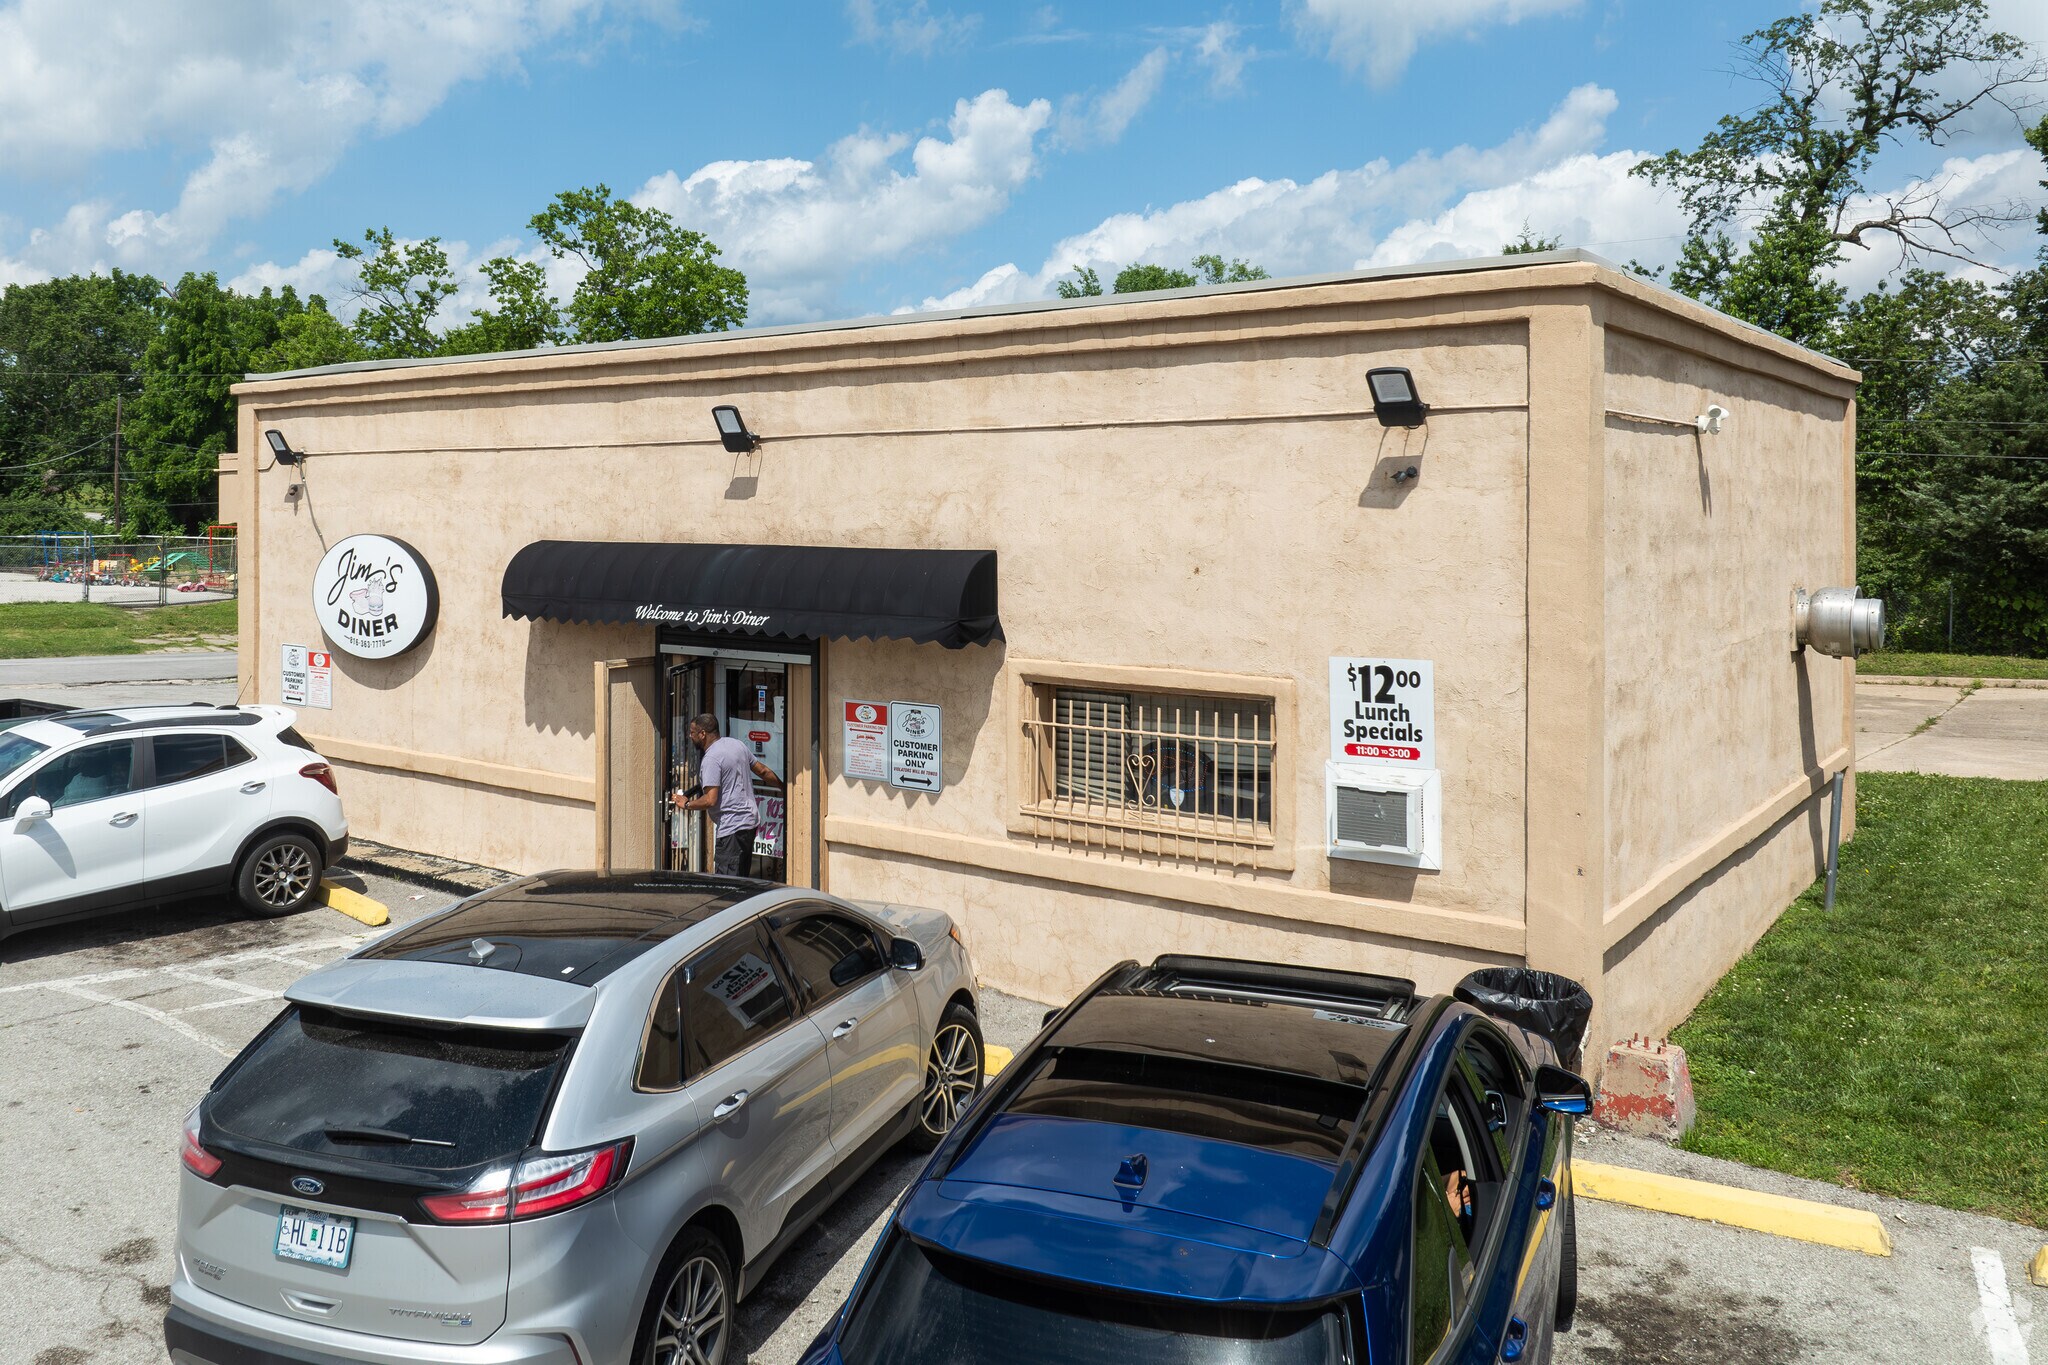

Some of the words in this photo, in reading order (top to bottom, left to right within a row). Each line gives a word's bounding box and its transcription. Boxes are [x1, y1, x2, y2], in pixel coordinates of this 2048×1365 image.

[327, 548, 403, 606] Jim's
[337, 608, 399, 637] DINER
[635, 604, 684, 620] Welcome
[684, 610, 699, 623] to
[697, 608, 731, 625] Jim's
[732, 610, 770, 626] Diner
[283, 670, 305, 678] CUSTOMER
[285, 677, 303, 685] PARKING
[1354, 701, 1410, 722] Lunch
[1343, 719, 1424, 743] Specials
[893, 740, 938, 752] CUSTOMER
[897, 749, 934, 760] PARKING
[1355, 746, 1380, 757] 11:00
[1388, 748, 1411, 759] 3:00
[905, 759, 926, 768] ONLY
[755, 821, 783, 844] MZ!
[290, 1218, 308, 1247] HL
[317, 1223, 348, 1254] 11B
[388, 1307, 472, 1321] TITANIUM
